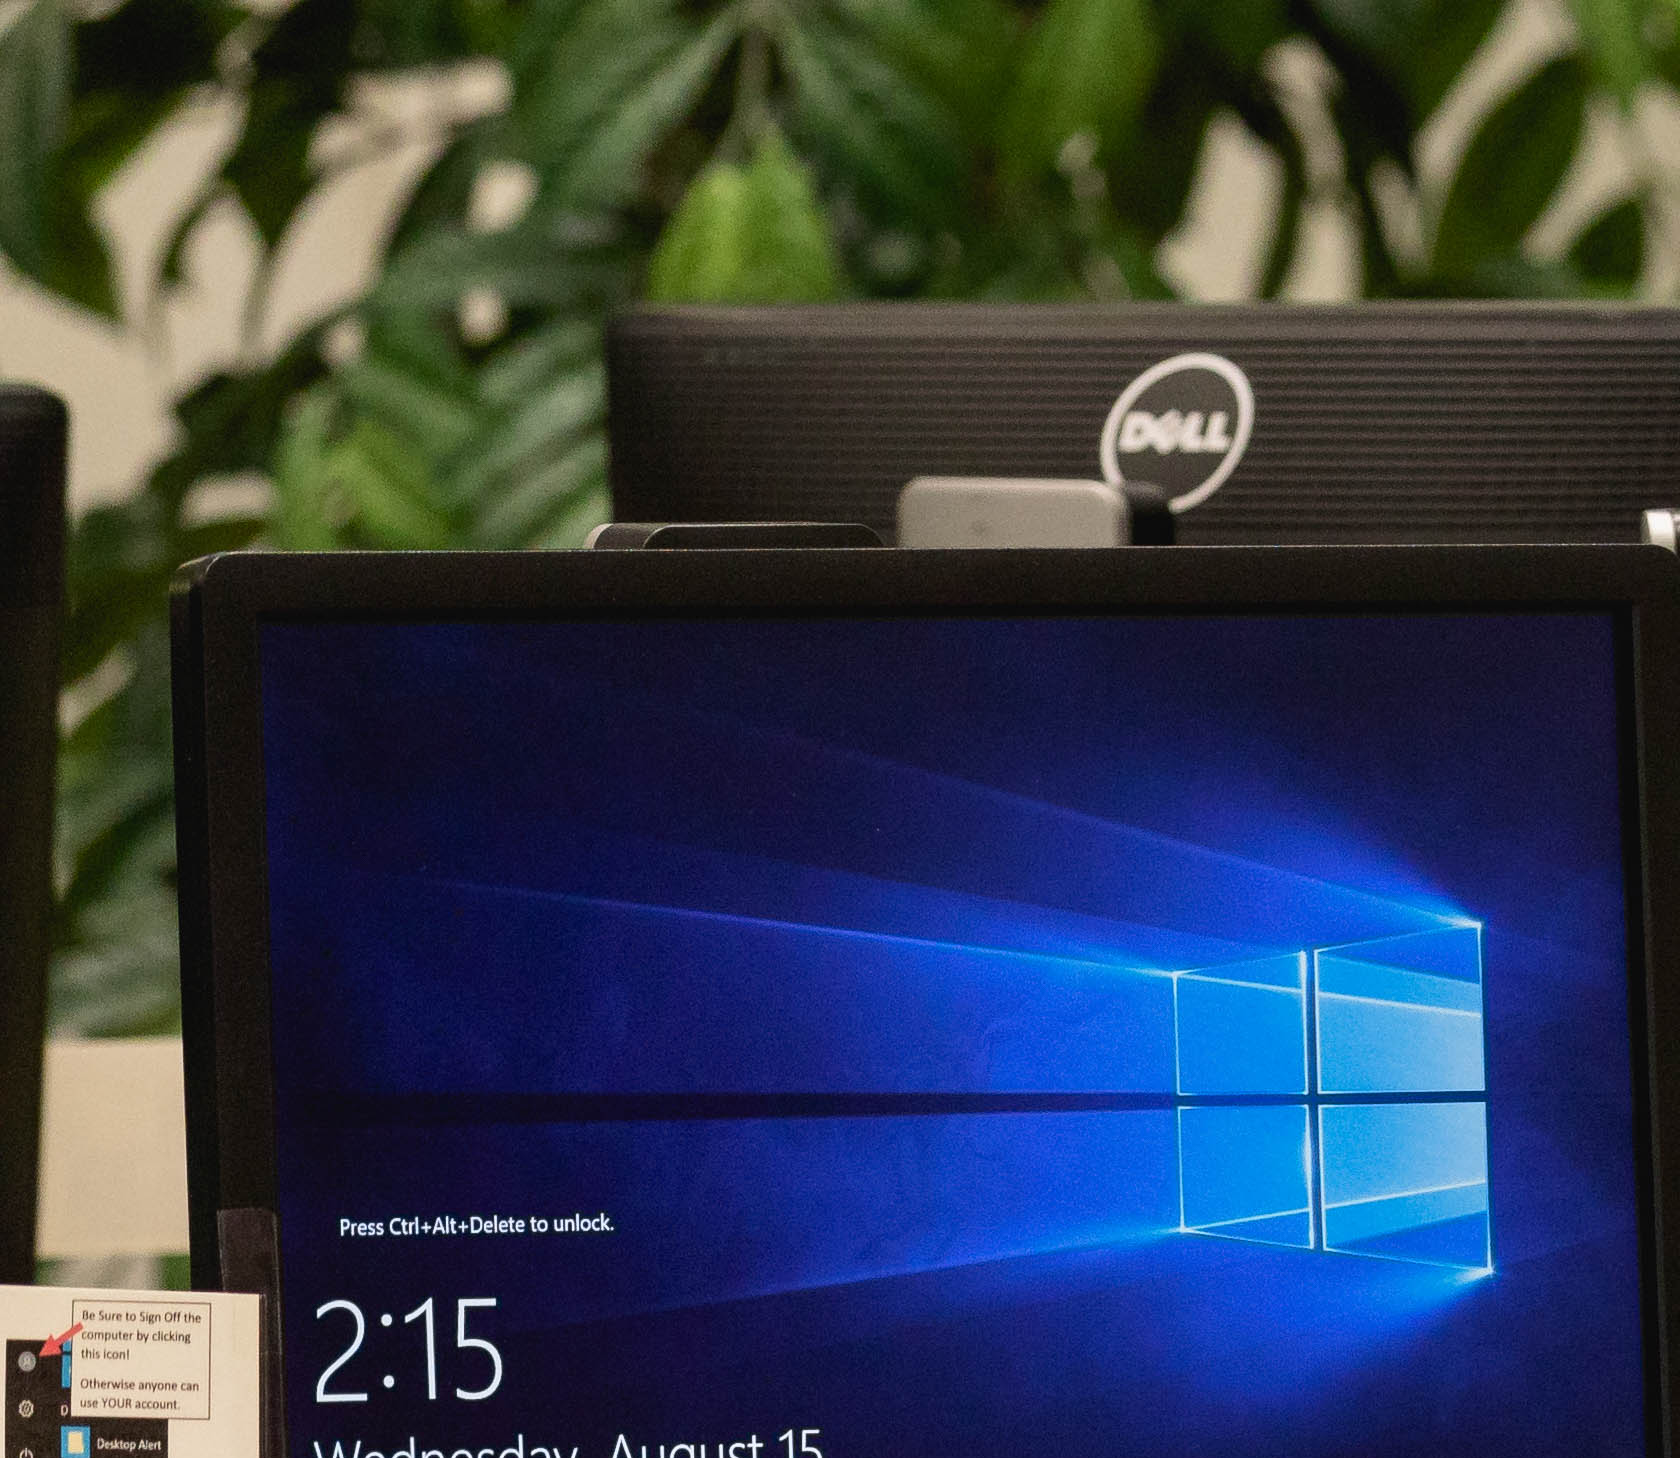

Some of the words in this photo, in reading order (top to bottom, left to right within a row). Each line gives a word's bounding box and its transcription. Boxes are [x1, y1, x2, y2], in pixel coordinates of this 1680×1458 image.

[1117, 409, 1232, 455] DELL
[340, 1215, 385, 1238] Press
[388, 1215, 525, 1236] Ctrl+Alt+Delete
[530, 1218, 549, 1234] to
[553, 1213, 615, 1233] unlock.
[82, 1310, 96, 1321] Be
[98, 1310, 122, 1322] Sure
[125, 1312, 137, 1322] to
[139, 1311, 161, 1325] Sign
[164, 1311, 181, 1322] Off
[184, 1312, 202, 1324] the
[81, 1331, 133, 1342] computer
[136, 1330, 149, 1343] by
[151, 1330, 191, 1344] clicking
[81, 1348, 100, 1360] this
[103, 1348, 130, 1361] icon!
[315, 1297, 503, 1402] 2:15
[80, 1378, 136, 1390] Otherwise
[138, 1381, 178, 1392] anyone
[180, 1381, 200, 1392] can
[80, 1399, 98, 1409] use
[101, 1398, 132, 1409] YOUR
[135, 1399, 180, 1410] account.
[96, 1437, 137, 1452] Desktop
[138, 1439, 162, 1451] Alert
